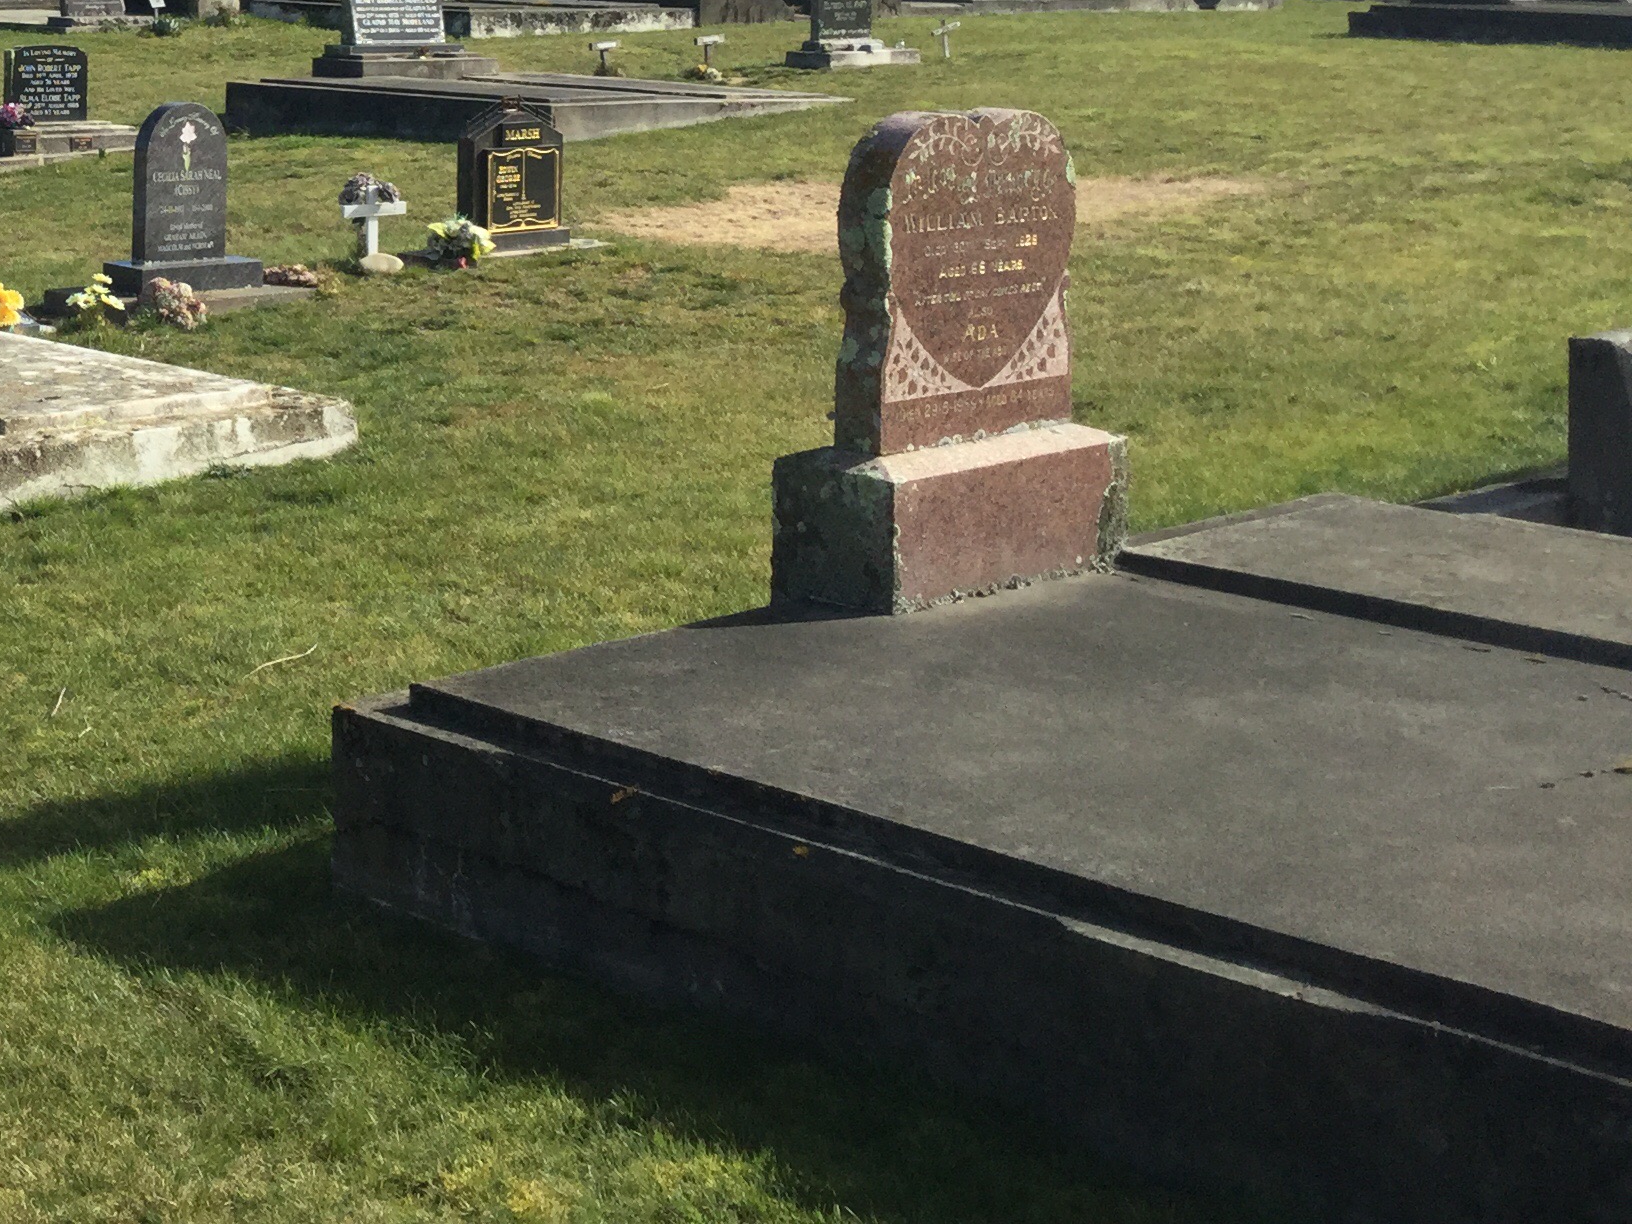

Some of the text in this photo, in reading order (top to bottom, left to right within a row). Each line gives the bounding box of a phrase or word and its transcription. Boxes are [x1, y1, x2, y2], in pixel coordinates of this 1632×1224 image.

[505, 128, 540, 141] MARSH
[153, 169, 221, 182] CECILIA SARAH NEAL
[903, 205, 1059, 234] WILLIAM BARTON
[924, 244, 946, 258] DIED
[938, 265, 966, 280] AGED
[962, 323, 999, 344] ADA
